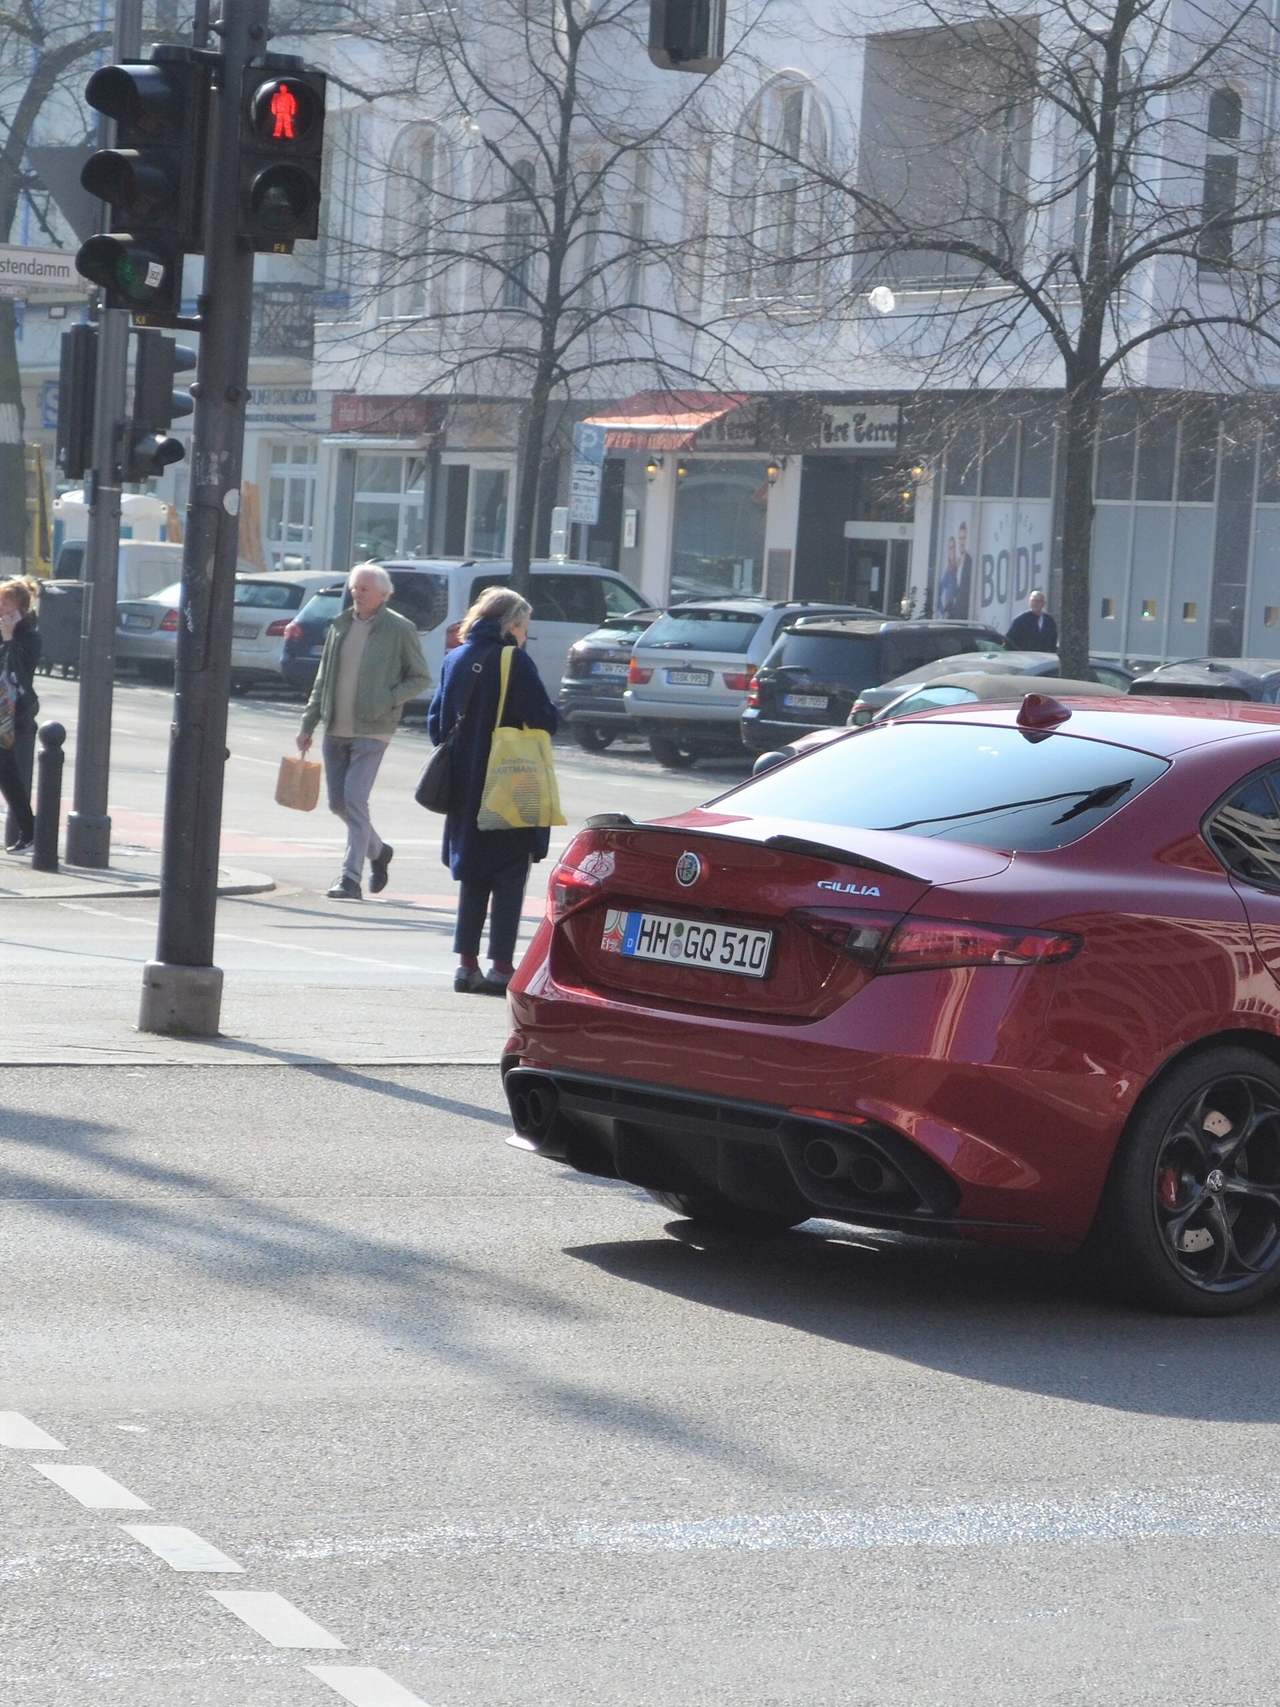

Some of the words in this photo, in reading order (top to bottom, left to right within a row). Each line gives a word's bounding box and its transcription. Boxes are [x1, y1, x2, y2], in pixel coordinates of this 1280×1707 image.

[0, 257, 70, 278] stendamm
[981, 542, 1044, 609] BODE
[816, 880, 882, 898] GIULIA
[627, 938, 634, 948] D
[637, 918, 671, 955] HH
[683, 926, 717, 962] GQ
[720, 931, 767, 970] 510
